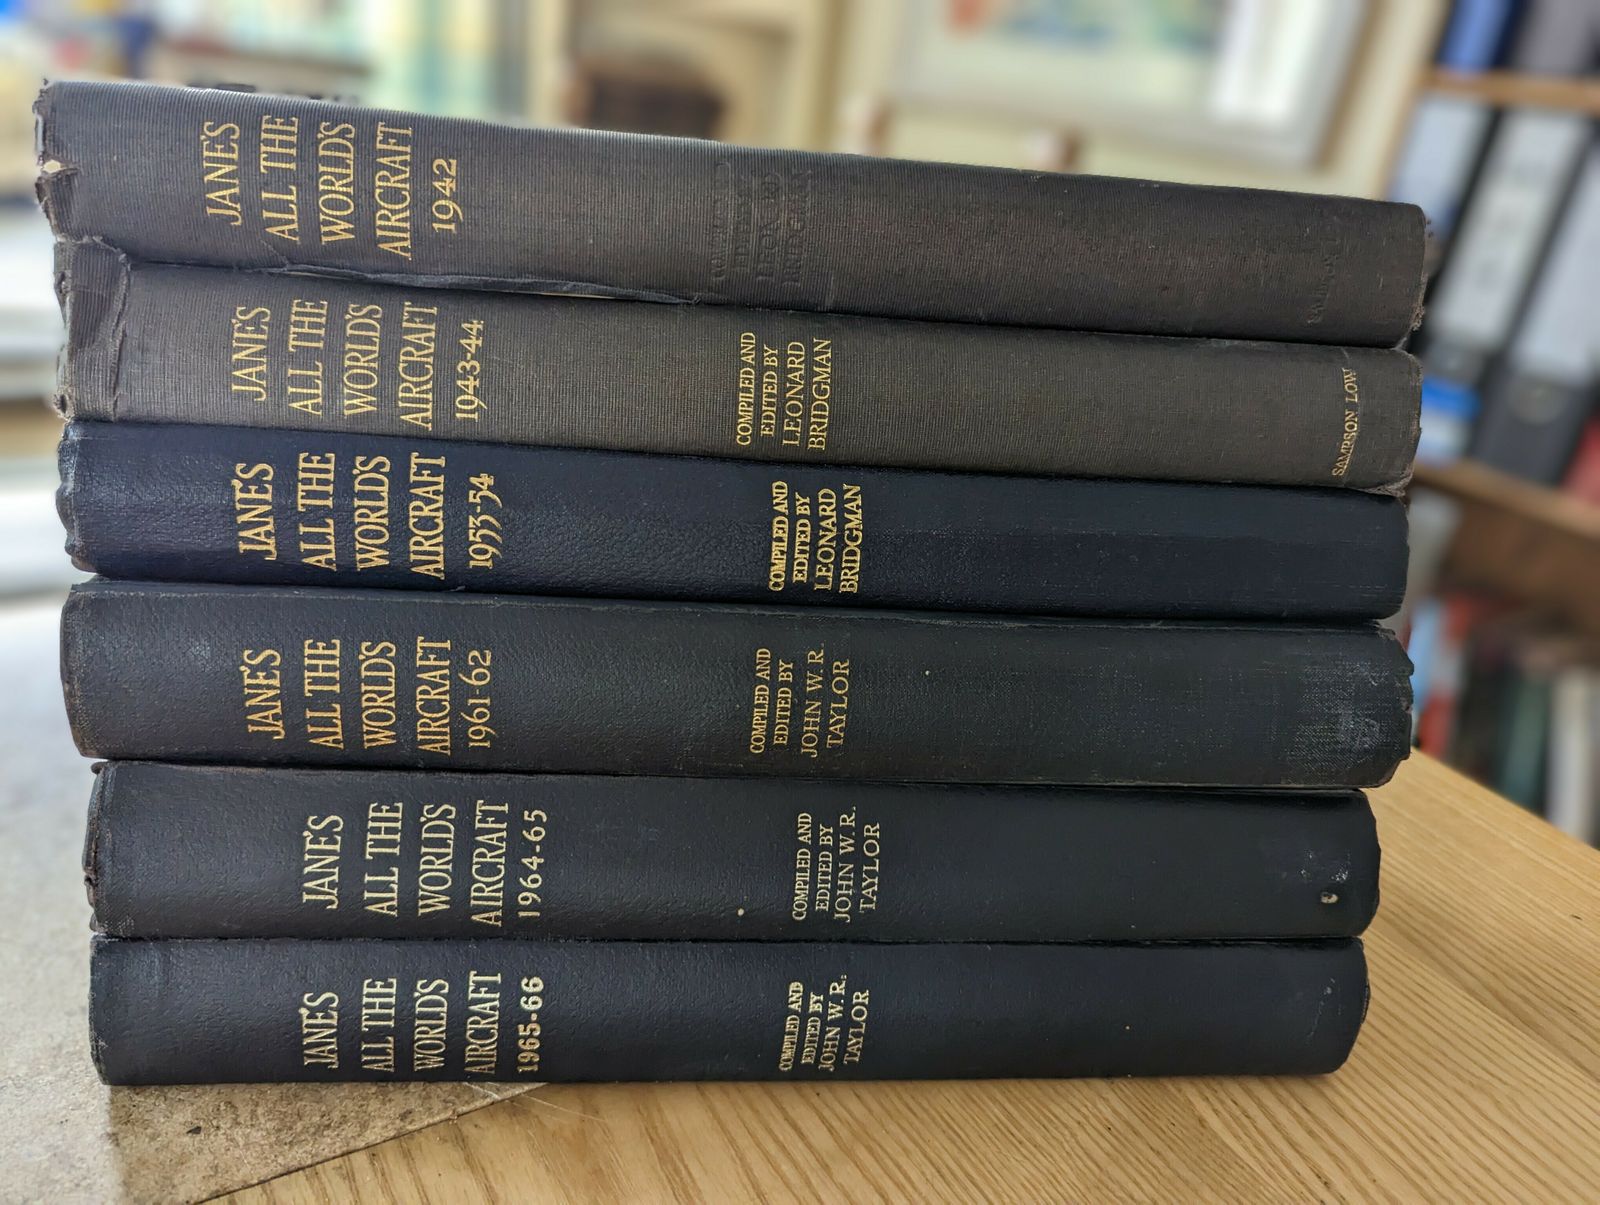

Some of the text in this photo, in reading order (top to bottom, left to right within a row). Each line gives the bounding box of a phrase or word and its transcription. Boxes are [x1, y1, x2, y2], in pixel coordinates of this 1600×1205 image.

[200, 121, 241, 226] JANE'S
[260, 115, 299, 241] ALL THE
[317, 121, 355, 244] WORLD'S
[374, 121, 412, 261] AIRCRAFT
[432, 158, 464, 234] 1942
[231, 306, 271, 402] JANE'S
[288, 299, 328, 417] ALL THE
[343, 303, 383, 420] WORLD'S
[398, 301, 438, 431] AIRCRAFT
[455, 320, 487, 423] 1943-44
[736, 331, 756, 446] COMPILED AND
[760, 343, 778, 437] EDITED BY
[782, 341, 806, 447] LEONARD
[807, 337, 832, 451] BRIDGMAN
[1332, 367, 1358, 476] SAMPSON LOW
[231, 462, 277, 561] JANE'S
[297, 452, 337, 572] ALL THE
[353, 455, 391, 572] WORLD'S
[408, 452, 446, 580] AIRCRAFT
[468, 473, 502, 570] 1953-54
[768, 480, 789, 592] COMPILED AND
[792, 492, 811, 584] EDITED BY
[814, 488, 837, 591] LEONARD
[838, 483, 862, 594] BRIDGMAN
[239, 648, 283, 740] JANE'S
[304, 638, 344, 750] ALL THE
[360, 641, 397, 750] WORLD'S
[416, 636, 451, 756] AIRCRAFT
[458, 649, 497, 749] 1961-62
[750, 648, 771, 754] COMPILED AND
[774, 658, 794, 746] EDITED BY
[801, 699, 822, 758] JOHN
[806, 669, 824, 693] W.
[826, 658, 850, 748] TAYLOR
[302, 815, 344, 910] JANE'S
[364, 802, 403, 918] ALL THE
[417, 803, 457, 917] WORLD'S
[470, 799, 509, 928] AIRCRAFT
[517, 809, 548, 918] 1964-65
[791, 812, 812, 921] COMPILED AND
[815, 823, 834, 912] EDITED BY
[833, 805, 857, 924] JOHN W. R.
[859, 822, 880, 914] TAYLOR
[299, 991, 340, 1070] JANE'S
[361, 977, 397, 1073] ALL THE
[413, 978, 450, 1072] WORLD'S
[464, 970, 502, 1075] AIRCRAFT
[517, 976, 545, 1074] 1965-66
[778, 981, 804, 1072] COMPILED AND
[801, 991, 824, 1065] EDITED BY
[818, 974, 847, 1072] JOHN W. R.
[843, 989, 869, 1065] TAYLOR
